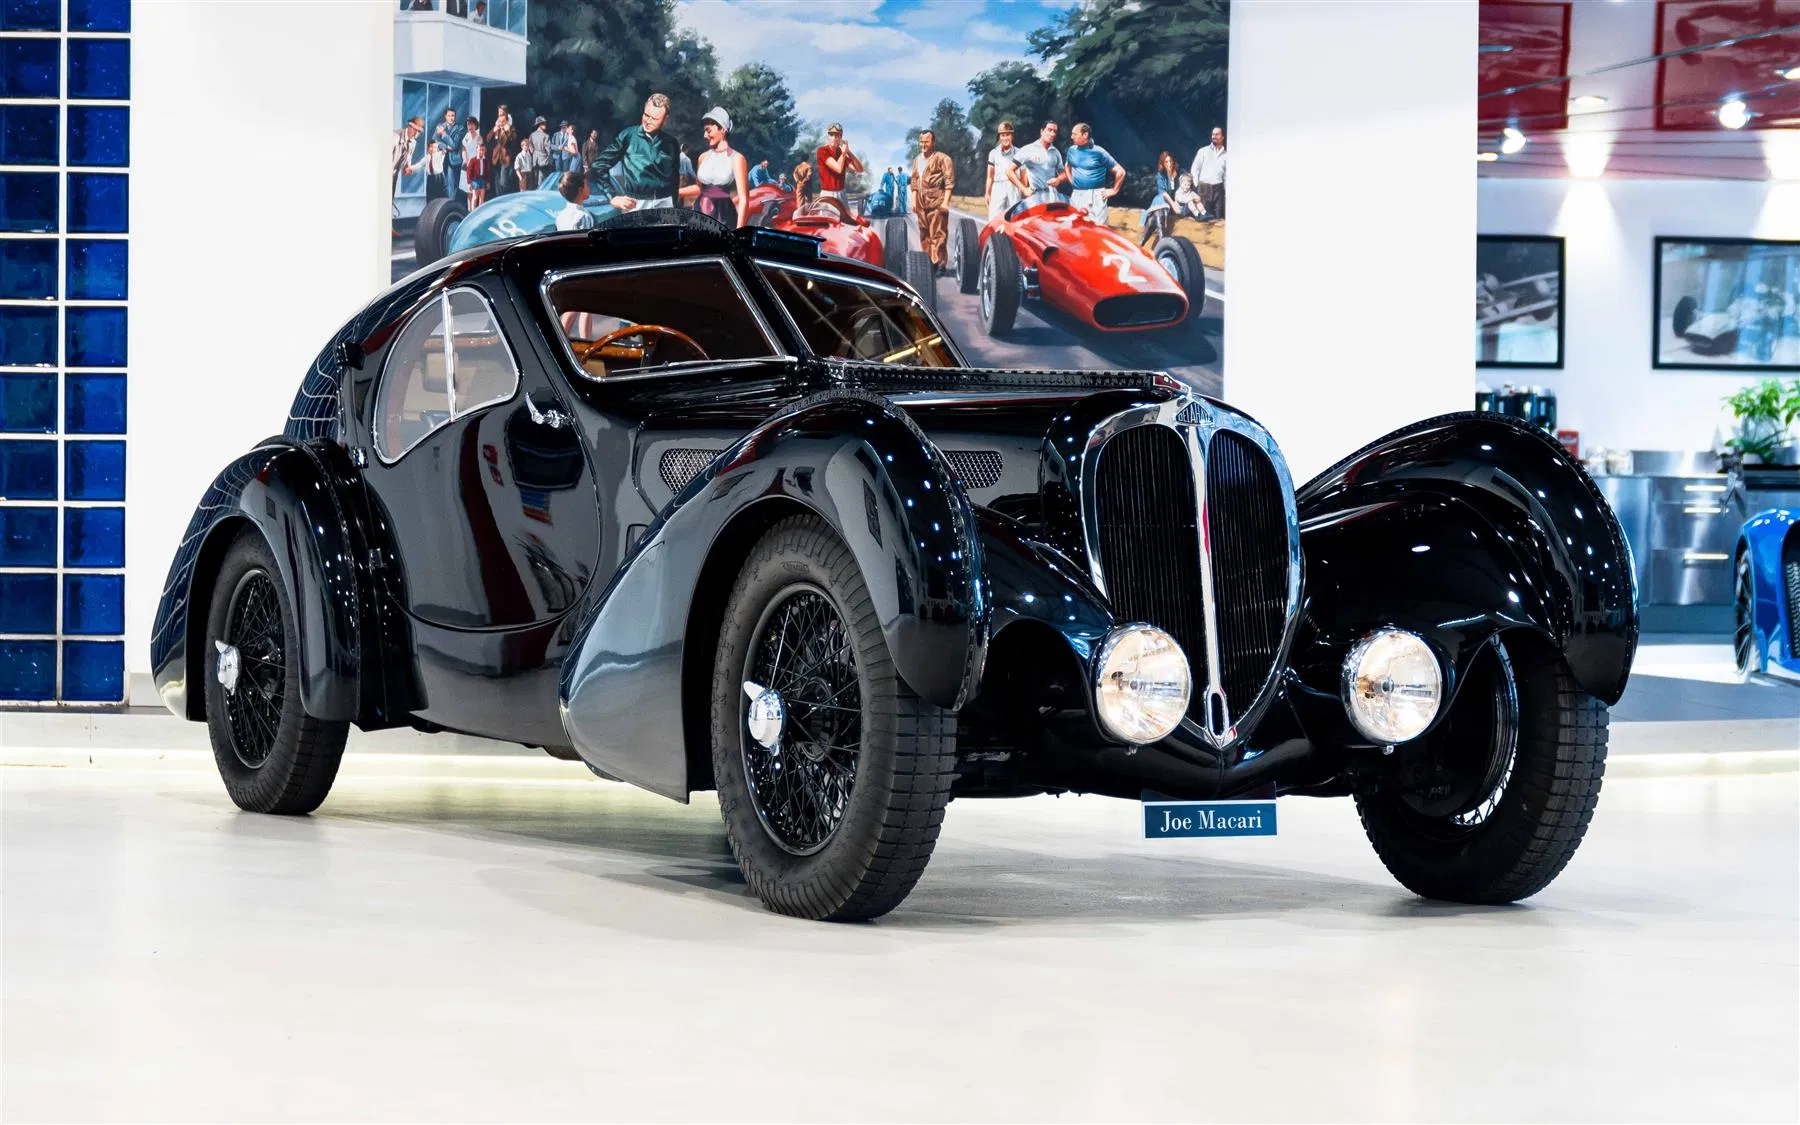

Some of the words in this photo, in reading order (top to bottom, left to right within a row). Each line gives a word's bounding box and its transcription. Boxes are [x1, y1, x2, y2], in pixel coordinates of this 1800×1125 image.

[1102, 254, 1147, 283] 2
[1160, 810, 1192, 833] Joe
[1197, 809, 1262, 830] Macari
